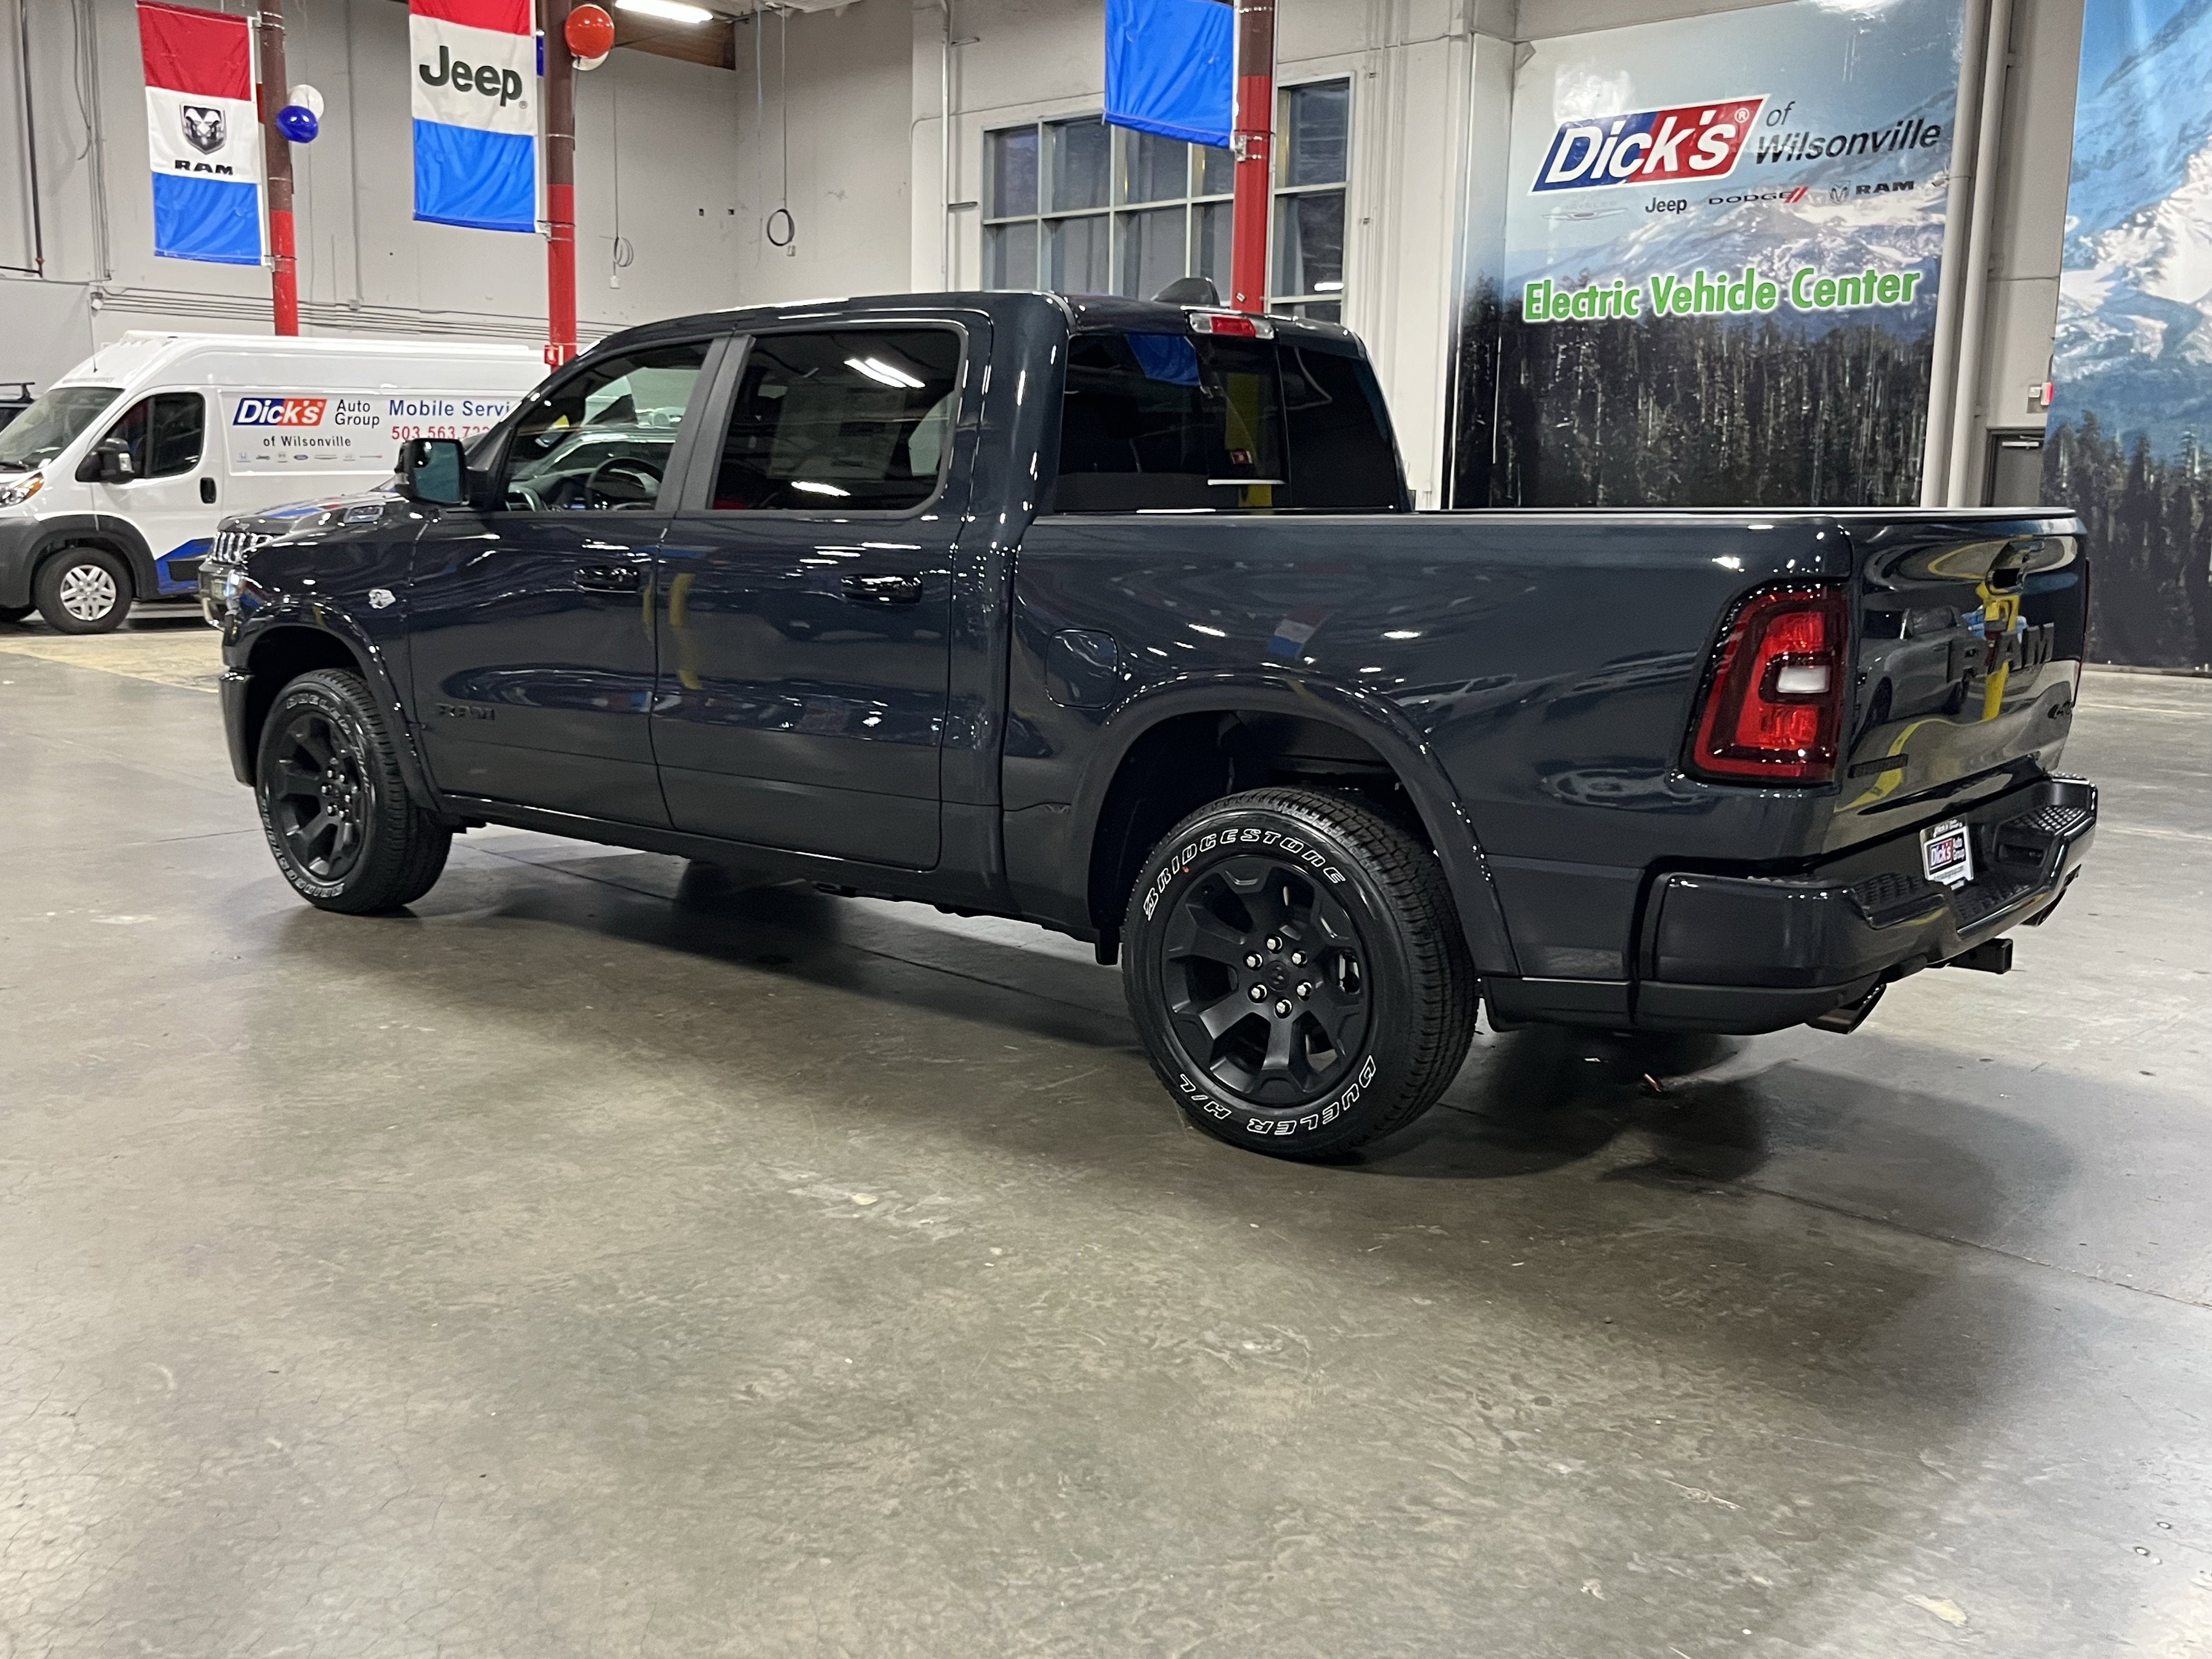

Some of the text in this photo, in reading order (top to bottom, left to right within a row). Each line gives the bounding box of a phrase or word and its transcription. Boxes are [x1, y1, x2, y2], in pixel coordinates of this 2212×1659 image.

[419, 45, 522, 107] Jeep
[1765, 101, 1796, 127] of
[1545, 109, 1736, 184] Dick's
[1756, 117, 1941, 165] Wilsonville
[174, 160, 233, 176] RAM
[1708, 191, 1790, 205] DODGE
[1855, 180, 1915, 195] RAM
[1645, 197, 1688, 215] Jeep
[1525, 267, 1920, 320] Electric Vehicle Center
[237, 399, 320, 425] Dick's
[336, 399, 371, 413] Auto
[390, 400, 454, 416] Mobile
[335, 413, 380, 428] Group
[263, 436, 351, 447] of Wilsonville
[1946, 622, 2054, 684] RAM
[1143, 828, 1346, 921] BRIDGESTONE
[1180, 1074, 1232, 1120] H/L
[1246, 1055, 1376, 1135] DUELER
